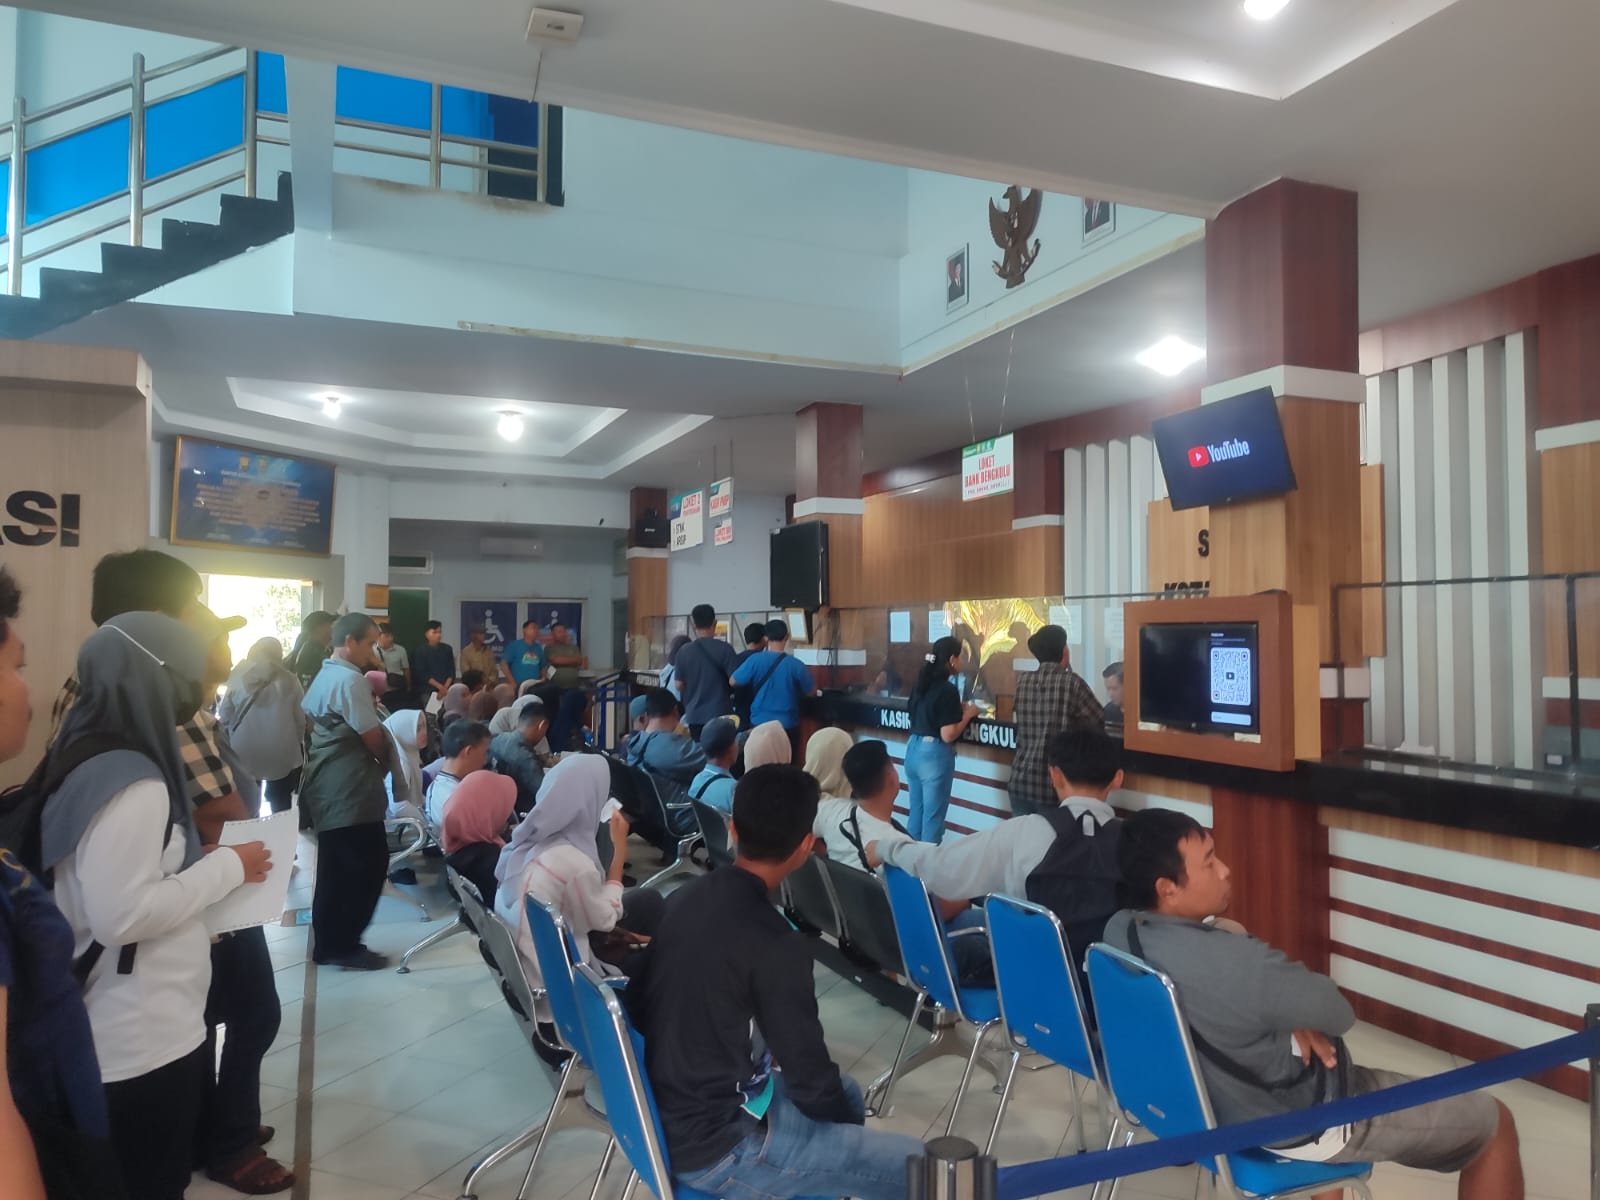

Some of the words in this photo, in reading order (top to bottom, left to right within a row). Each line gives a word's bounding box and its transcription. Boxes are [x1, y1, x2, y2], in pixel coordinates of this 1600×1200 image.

[979, 455, 995, 470] LOKET
[1207, 438, 1250, 463] YouTube
[965, 473, 979, 487] BANK
[981, 464, 1010, 483] BENGKULU
[0, 490, 80, 547] SI
[963, 722, 1016, 748] ENGKUL
